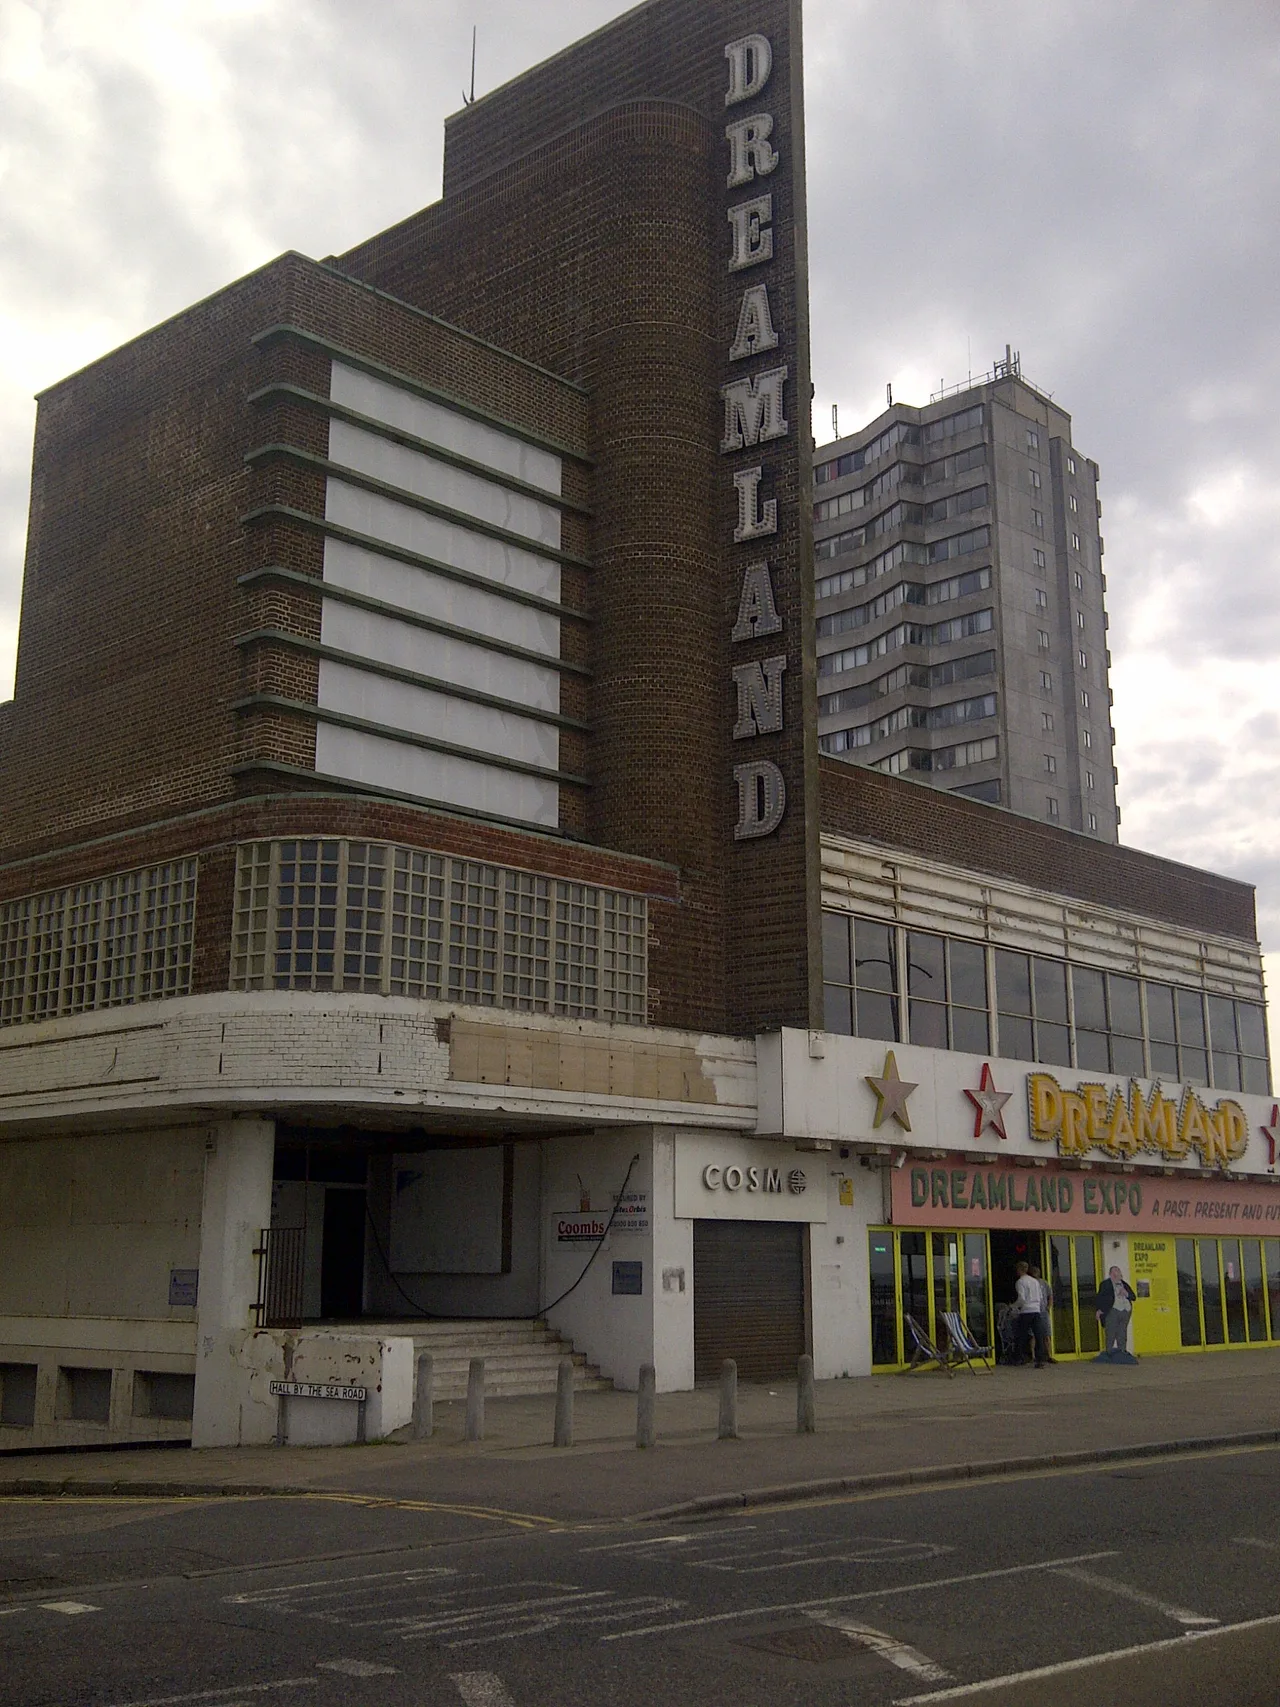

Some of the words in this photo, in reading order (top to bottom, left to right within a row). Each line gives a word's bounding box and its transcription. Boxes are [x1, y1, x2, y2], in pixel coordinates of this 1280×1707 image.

[720, 32, 789, 842] DREAMLAND
[1028, 1072, 1249, 1169] DREAMLAND
[911, 1168, 1073, 1213] DREAMLAND
[1083, 1177, 1143, 1216] EXPO
[1151, 1199, 1160, 1216] A
[1194, 1201, 1240, 1220] PRESENT
[1241, 1203, 1263, 1221] AND
[558, 1220, 605, 1235] Coombs
[1133, 1242, 1166, 1252] DREAMLAND
[1134, 1253, 1149, 1262] EXPO
[272, 1383, 291, 1394] HALL
[293, 1384, 304, 1395] BY
[308, 1385, 322, 1396] THE
[325, 1387, 339, 1397] SEA
[342, 1388, 364, 1399] ROAD
[578, 1525, 958, 1574] KEEP
